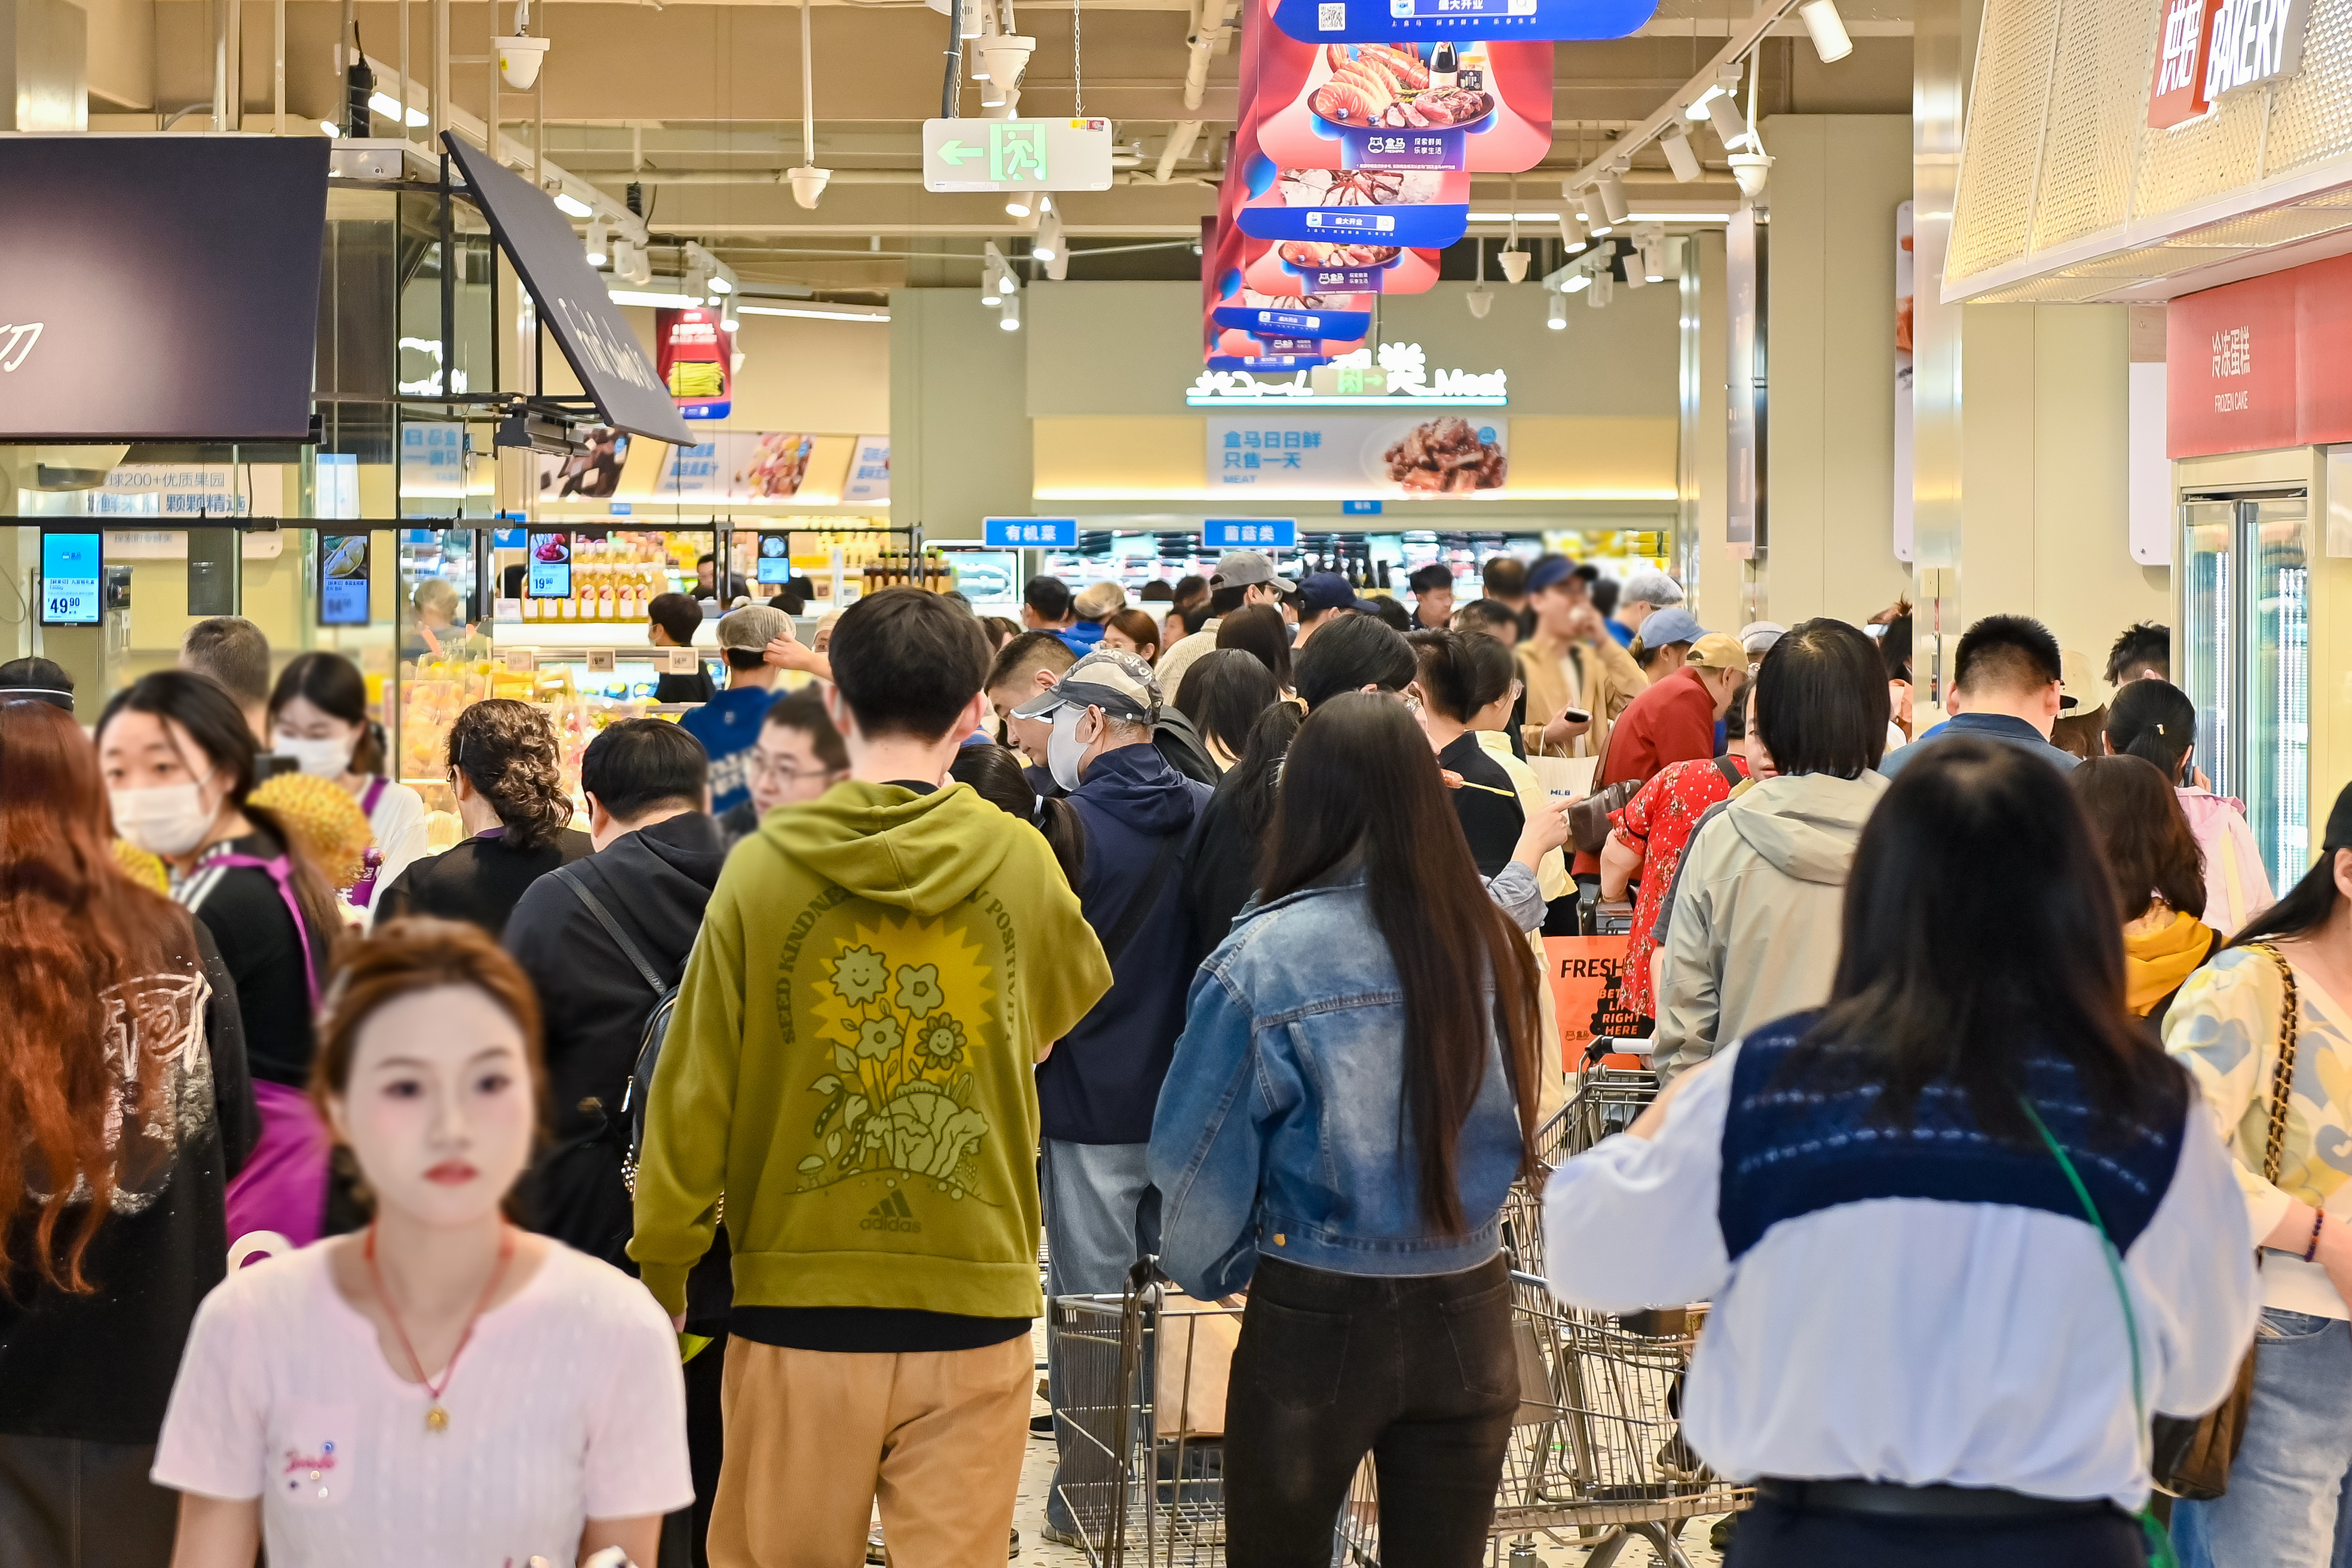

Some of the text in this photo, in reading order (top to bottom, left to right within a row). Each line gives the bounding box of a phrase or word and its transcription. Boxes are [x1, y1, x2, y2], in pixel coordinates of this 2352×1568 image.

[2203, 0, 2292, 102] BAKERY
[1385, 137, 1405, 149] 盒马
[2212, 326, 2250, 379] 冷冻蛋糕
[2215, 390, 2248, 413] FROZEN CAKE
[1224, 431, 1322, 449] 盒马日日鲜
[1224, 452, 1301, 470] 只售一天
[1223, 475, 1257, 484] MEAT
[166, 493, 246, 513] 颗颗精选
[776, 977, 795, 1044] SEED
[1602, 1013, 1641, 1024] RIGHT
[1604, 1025, 1639, 1036] HERE
[860, 1218, 922, 1233] adidas
